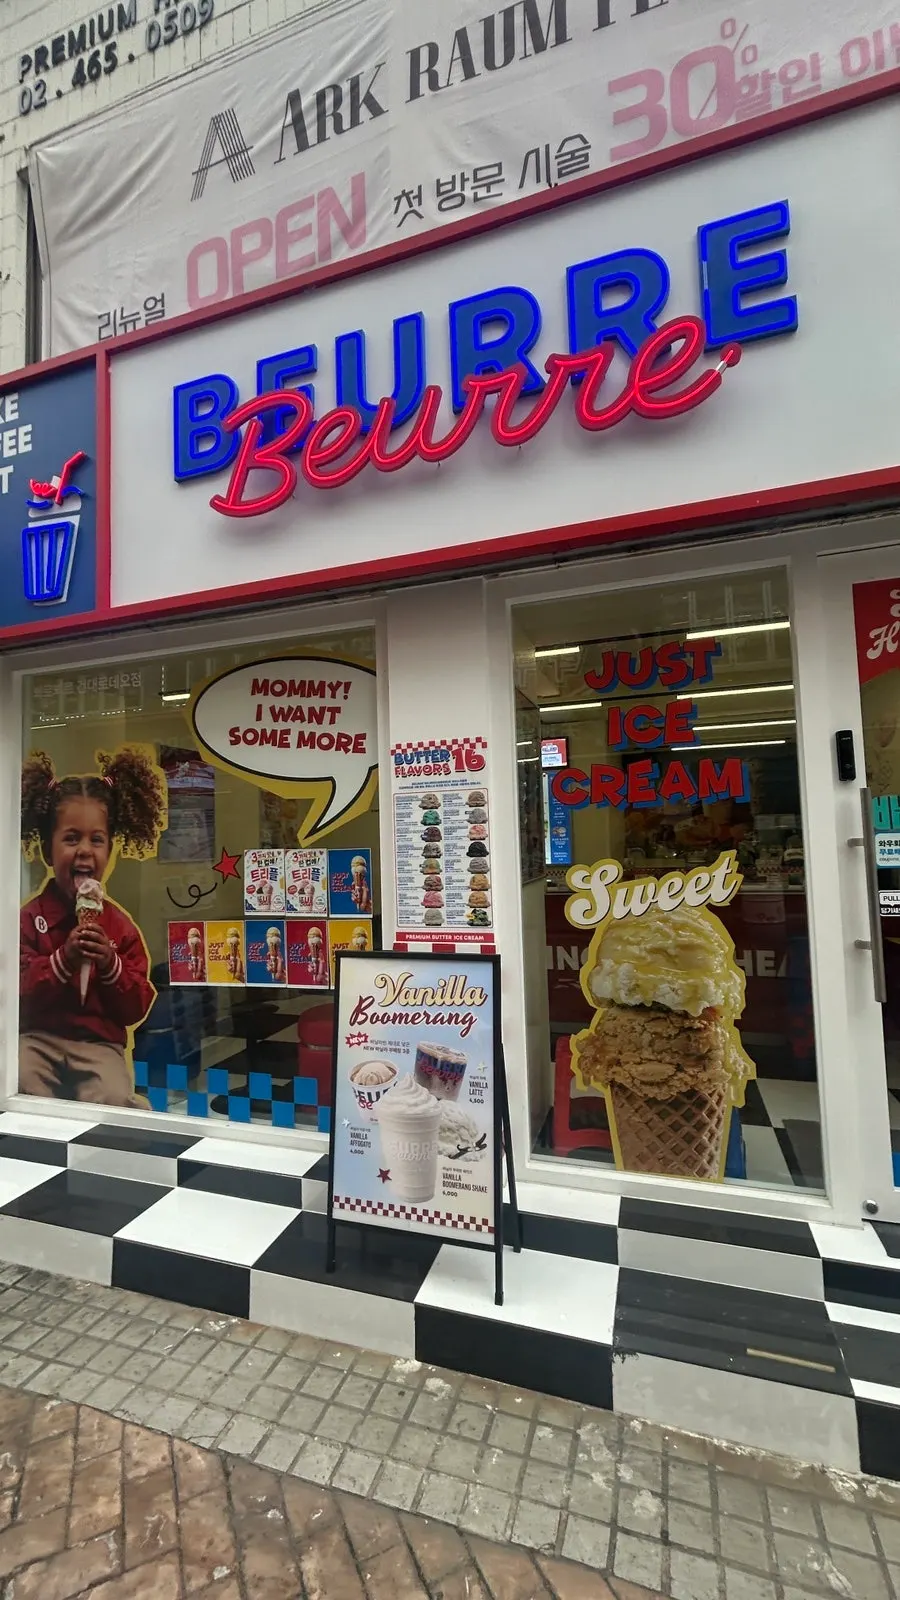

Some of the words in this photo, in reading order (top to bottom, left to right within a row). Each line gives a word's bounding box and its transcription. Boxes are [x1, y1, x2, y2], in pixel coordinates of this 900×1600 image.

[18, 0, 137, 84] PREMIUM
[274, 62, 390, 165] ARK
[404, 0, 573, 104] RAUM
[98, 293, 166, 341] 리뉴얼
[186, 172, 367, 312] OPEN
[393, 189, 423, 229] 첫
[436, 162, 505, 214] 방문
[518, 133, 592, 190] 시술
[173, 199, 799, 484] BEURRE
[209, 314, 742, 518] Beurre
[0, 423, 33, 458] EE
[584, 638, 722, 694] JUST
[250, 678, 352, 701] MOMMY!
[255, 703, 263, 722] I
[268, 704, 342, 726] WANT
[607, 698, 699, 750] ICE
[228, 726, 291, 749] SOME
[296, 730, 367, 755] MORE
[394, 748, 451, 766] BUTTER
[450, 746, 486, 773] 16
[394, 763, 452, 779] FLAVORS
[551, 757, 751, 812] CREAM
[250, 866, 279, 882] 트리플
[291, 866, 320, 883] 트리플
[569, 856, 738, 926] Sweet
[332, 942, 350, 950] JUST
[405, 933, 430, 941] PREMIUM
[374, 972, 488, 1007] Vanilla
[349, 995, 477, 1038] Boomerang
[349, 1036, 365, 1044] NEW
[469, 1081, 488, 1089] VANILLA
[469, 1089, 483, 1097] LATTE
[350, 1132, 368, 1140] VANILLA
[350, 1140, 371, 1148] AFFOGATO
[442, 1173, 462, 1181] VANILLA
[442, 1180, 472, 1191] BOOMERANG
[472, 1184, 488, 1194] SHAKE
